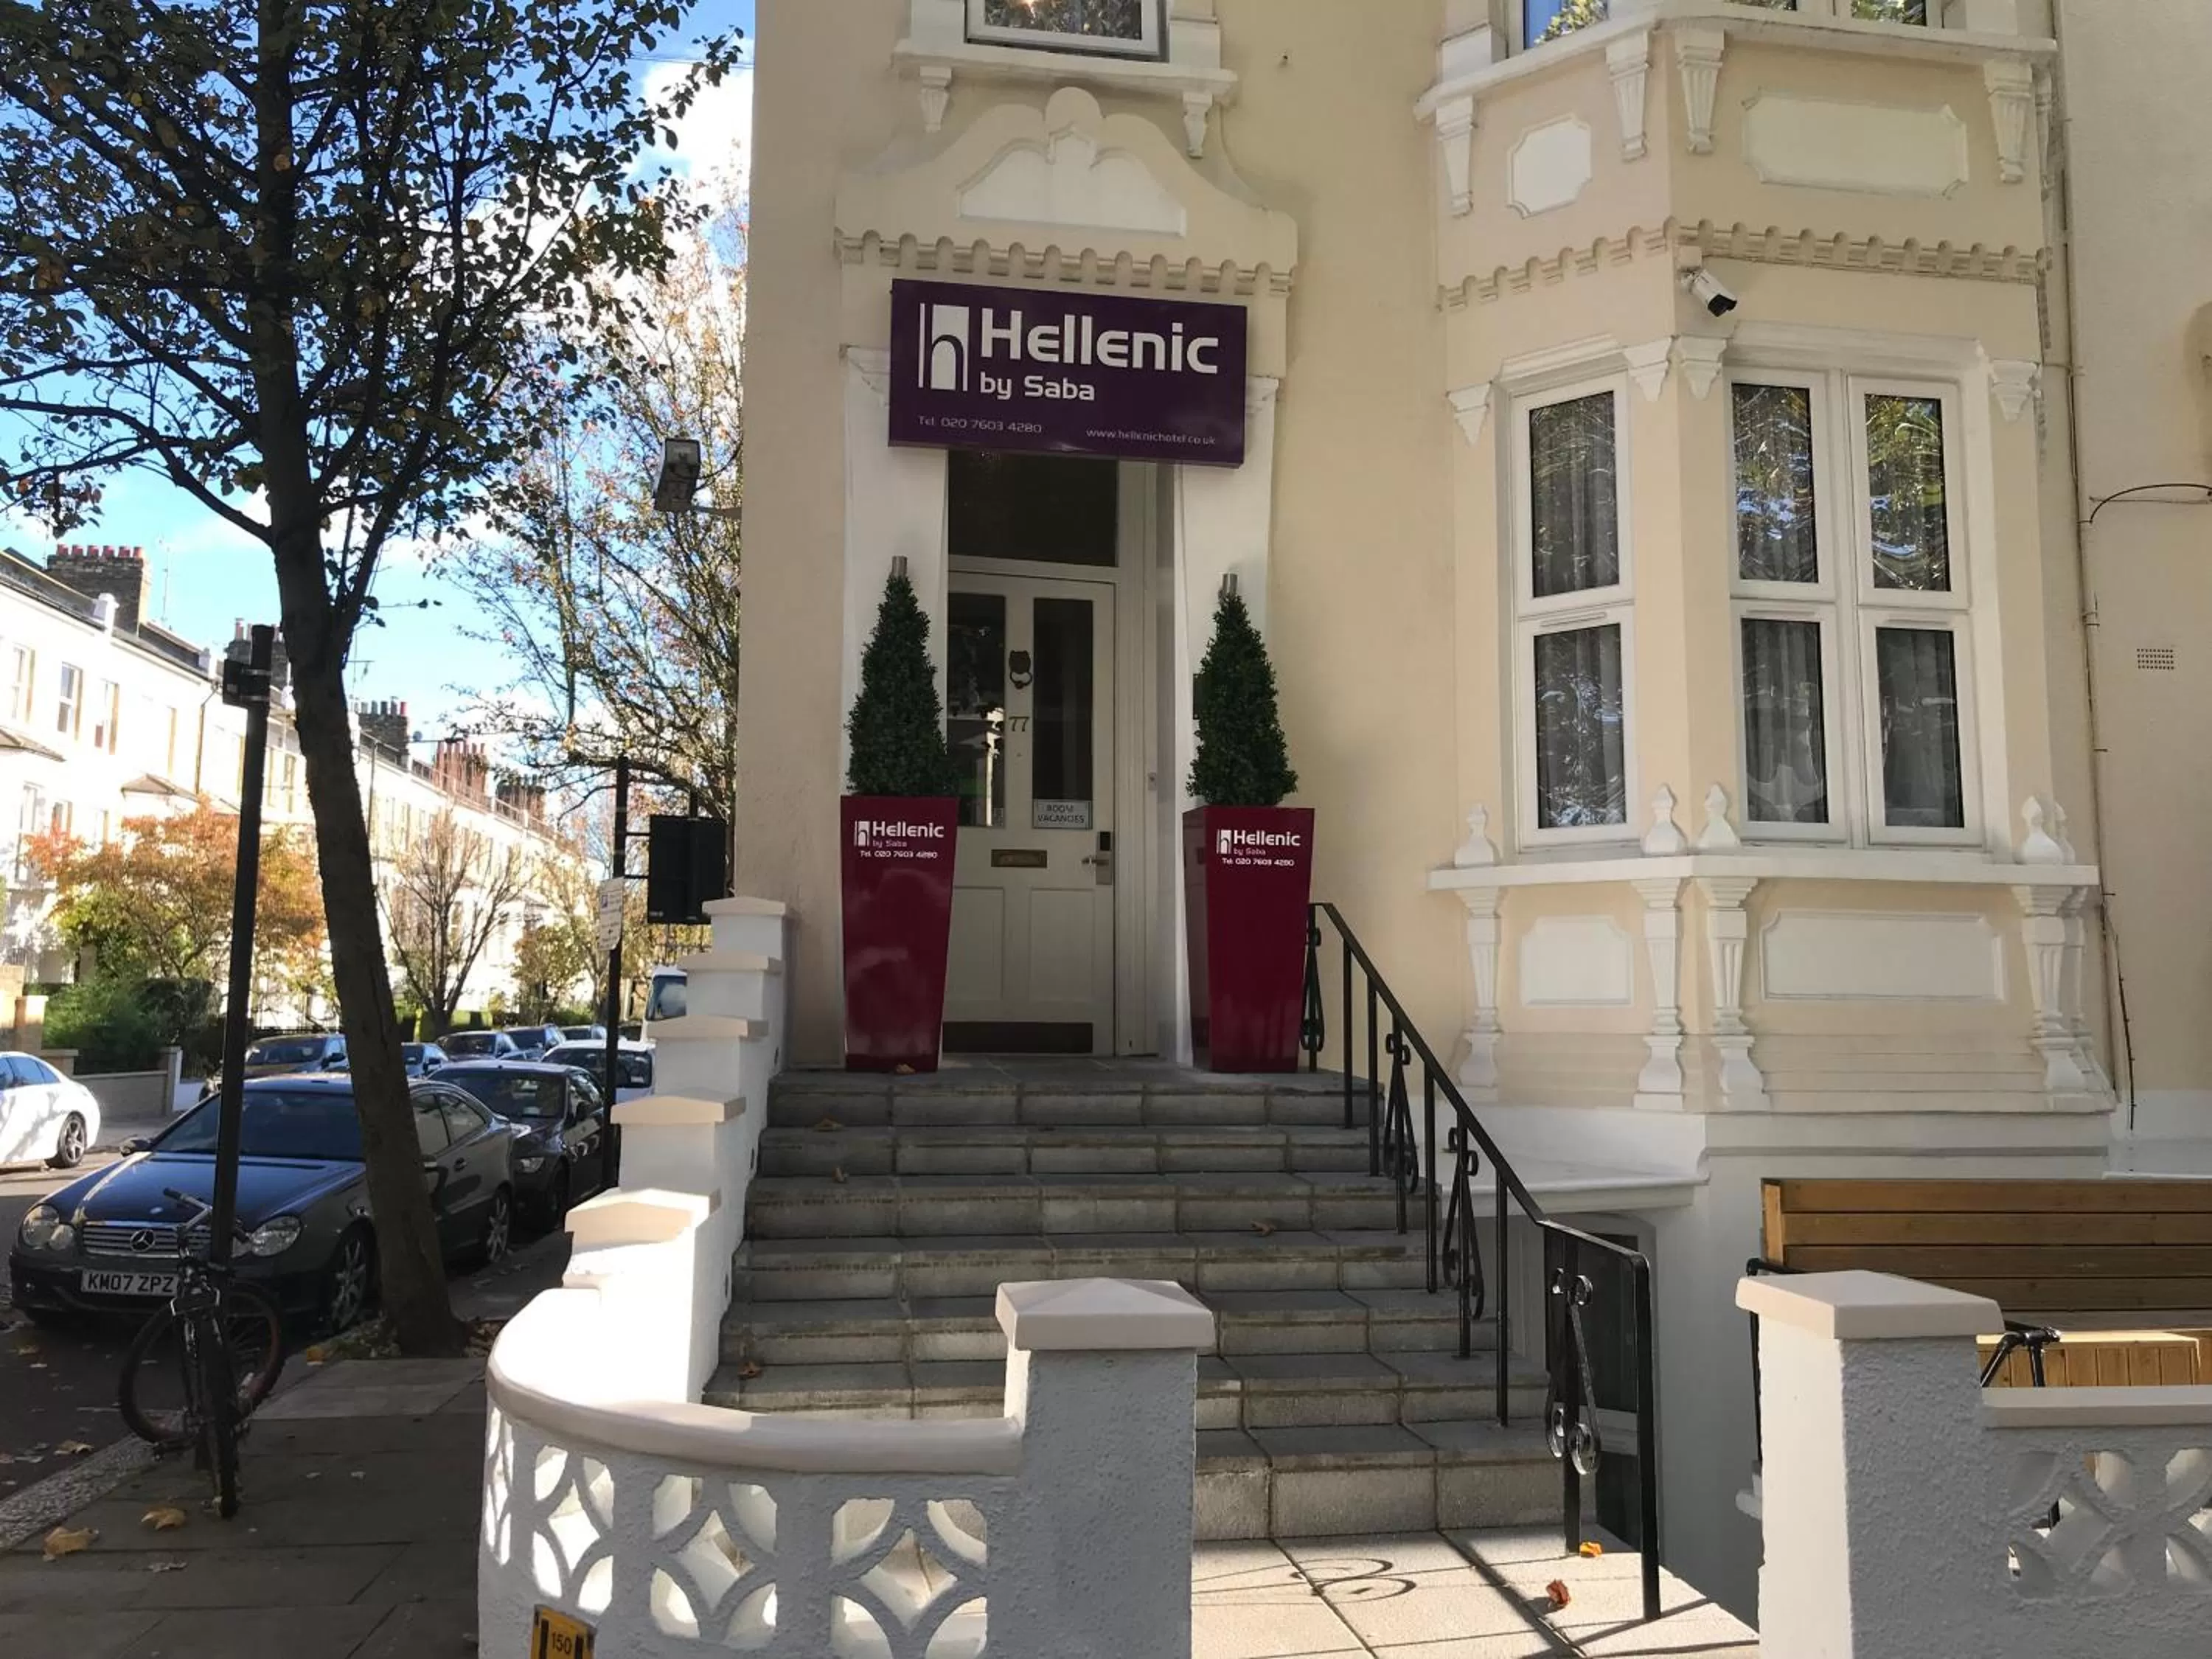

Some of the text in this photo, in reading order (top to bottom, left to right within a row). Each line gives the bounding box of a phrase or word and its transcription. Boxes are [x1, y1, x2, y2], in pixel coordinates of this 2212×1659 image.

[981, 307, 1219, 374] Hellenic
[979, 372, 1096, 401] by Saba
[941, 417, 968, 428] 020
[970, 419, 1004, 431] 7603
[1007, 422, 1043, 434] 4280
[1008, 716, 1030, 732] 77
[872, 821, 945, 838] Hellenic
[1233, 830, 1301, 846] Hellenic
[1233, 847, 1244, 855] by
[88, 1273, 174, 1293] KM07 ZPZ
[552, 1631, 572, 1655] 150
